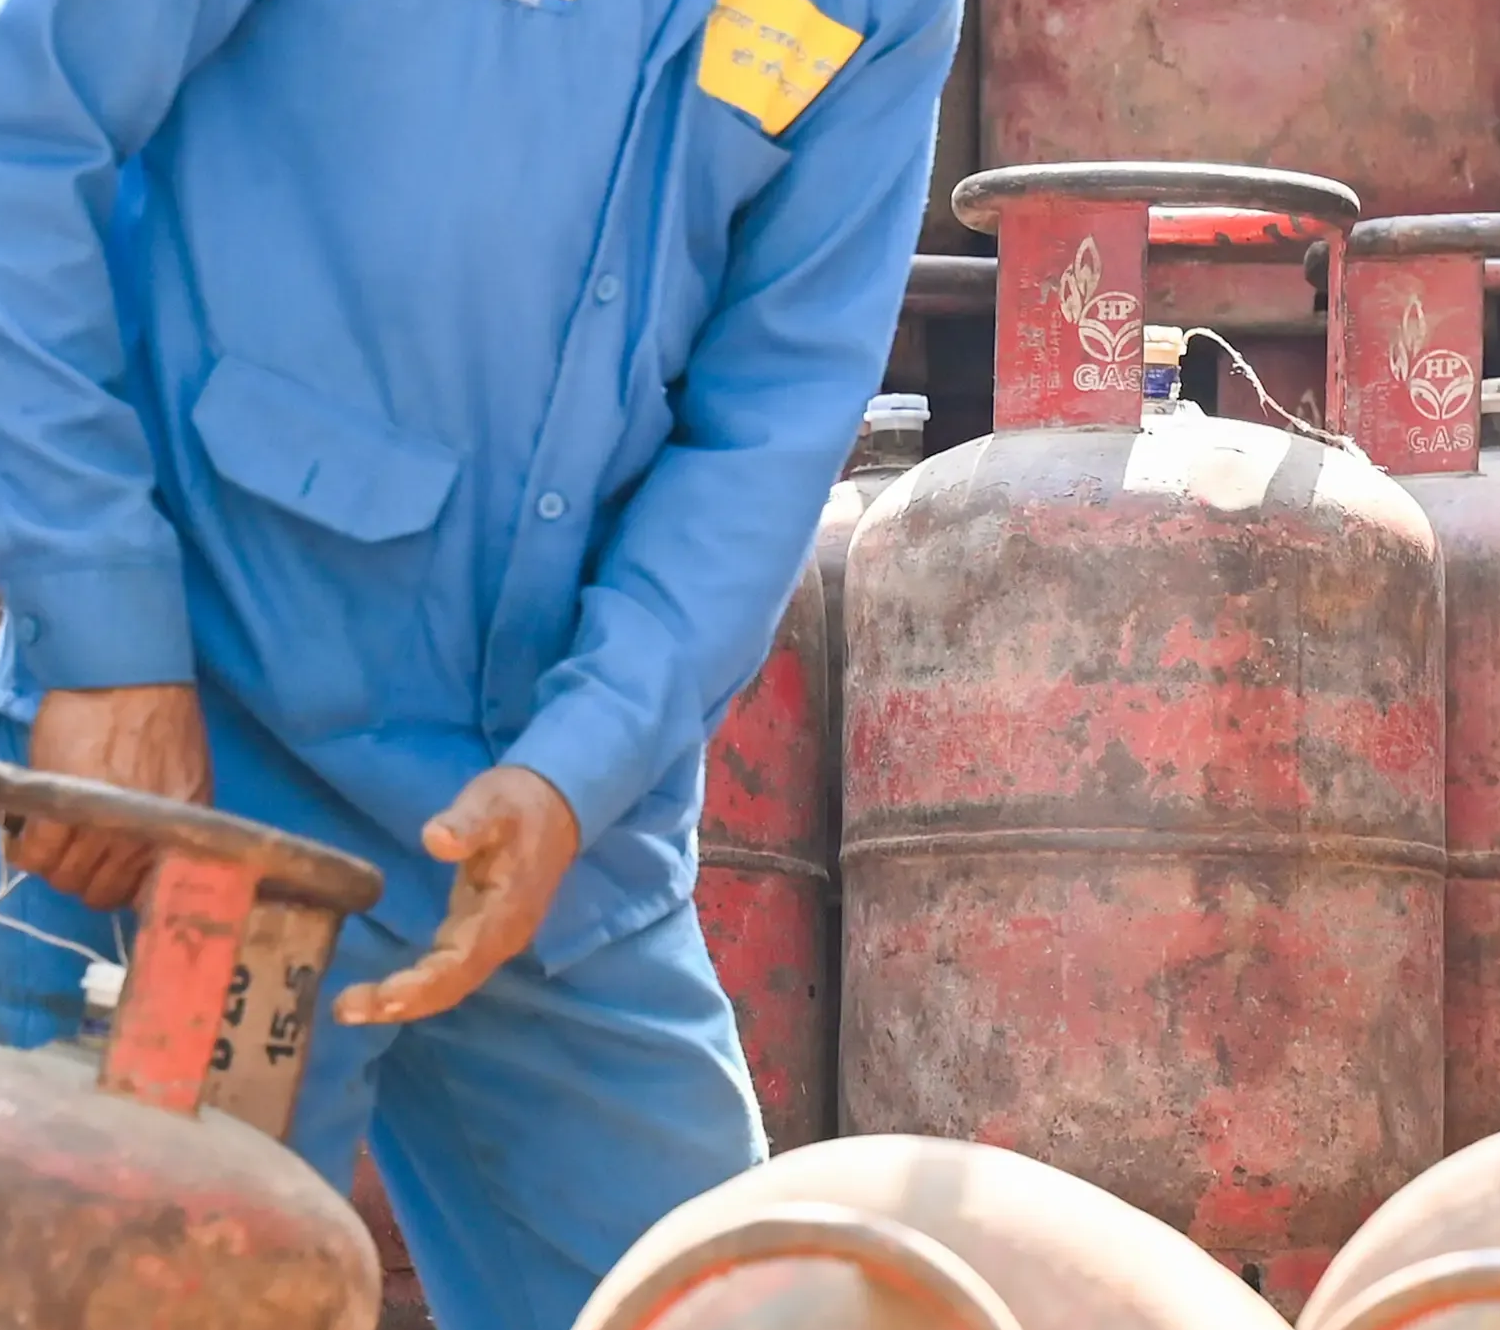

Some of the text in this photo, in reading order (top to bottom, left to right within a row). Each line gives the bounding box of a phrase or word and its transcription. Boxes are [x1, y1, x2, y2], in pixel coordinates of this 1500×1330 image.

[1097, 300, 1136, 321] HP
[1072, 363, 1144, 392] GAS
[1424, 357, 1463, 380] HP
[1407, 423, 1475, 454] GAS
